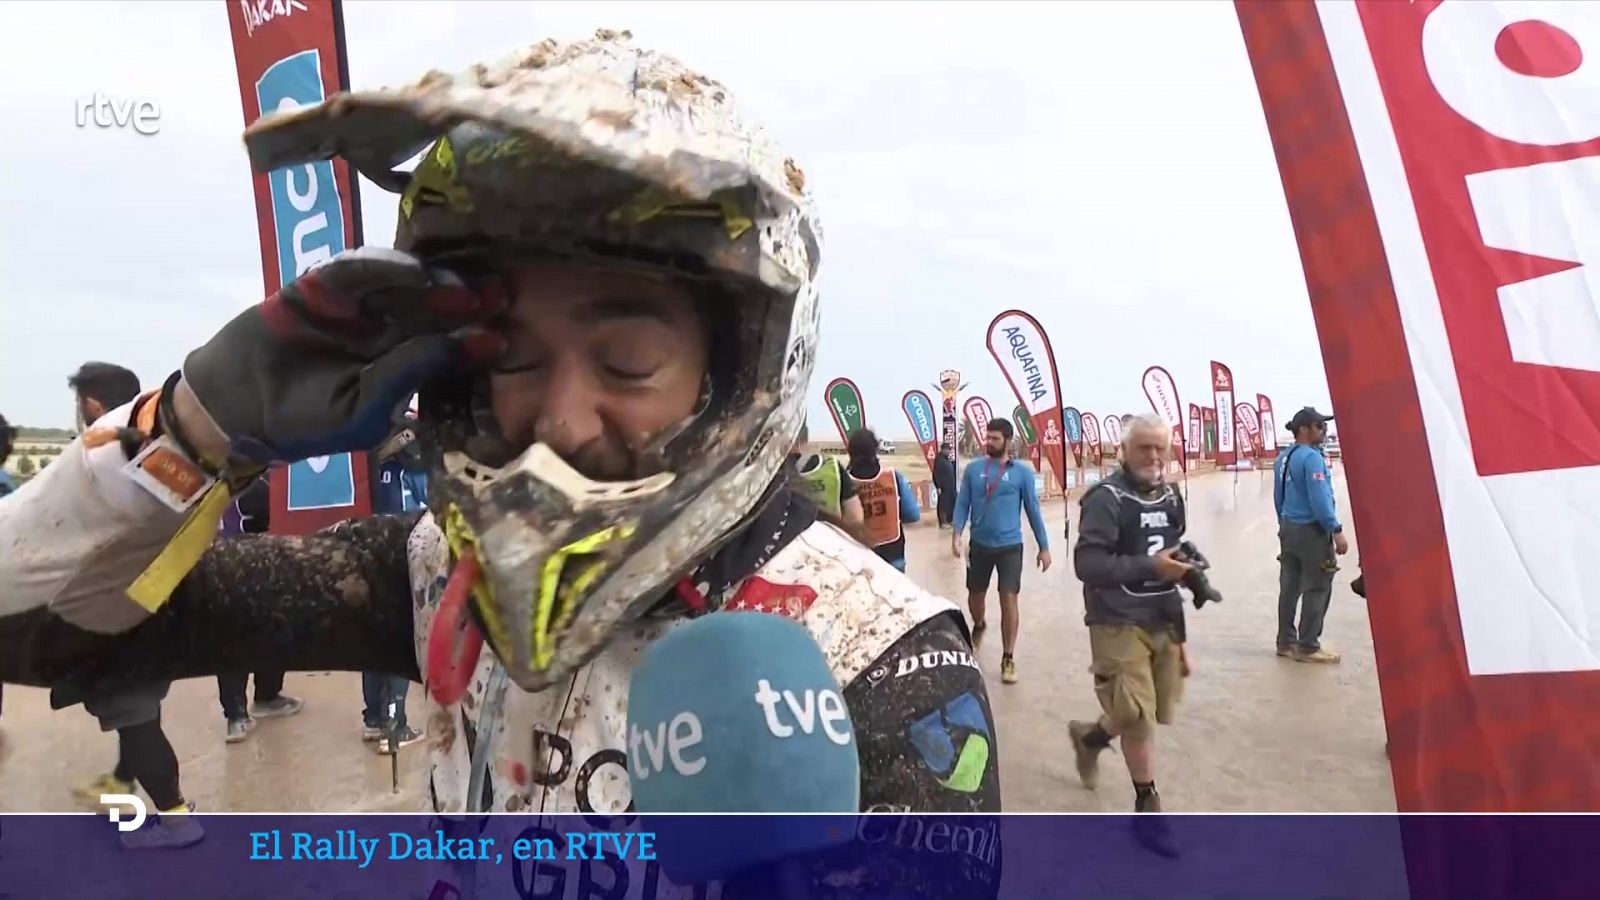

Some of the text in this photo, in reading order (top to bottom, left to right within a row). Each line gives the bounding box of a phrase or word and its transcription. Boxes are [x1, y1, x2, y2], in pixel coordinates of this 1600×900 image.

[1001, 326, 1048, 402] AQUAFINA
[1147, 534, 1165, 556] 2
[627, 711, 707, 780] tve
[754, 679, 851, 746] tve
